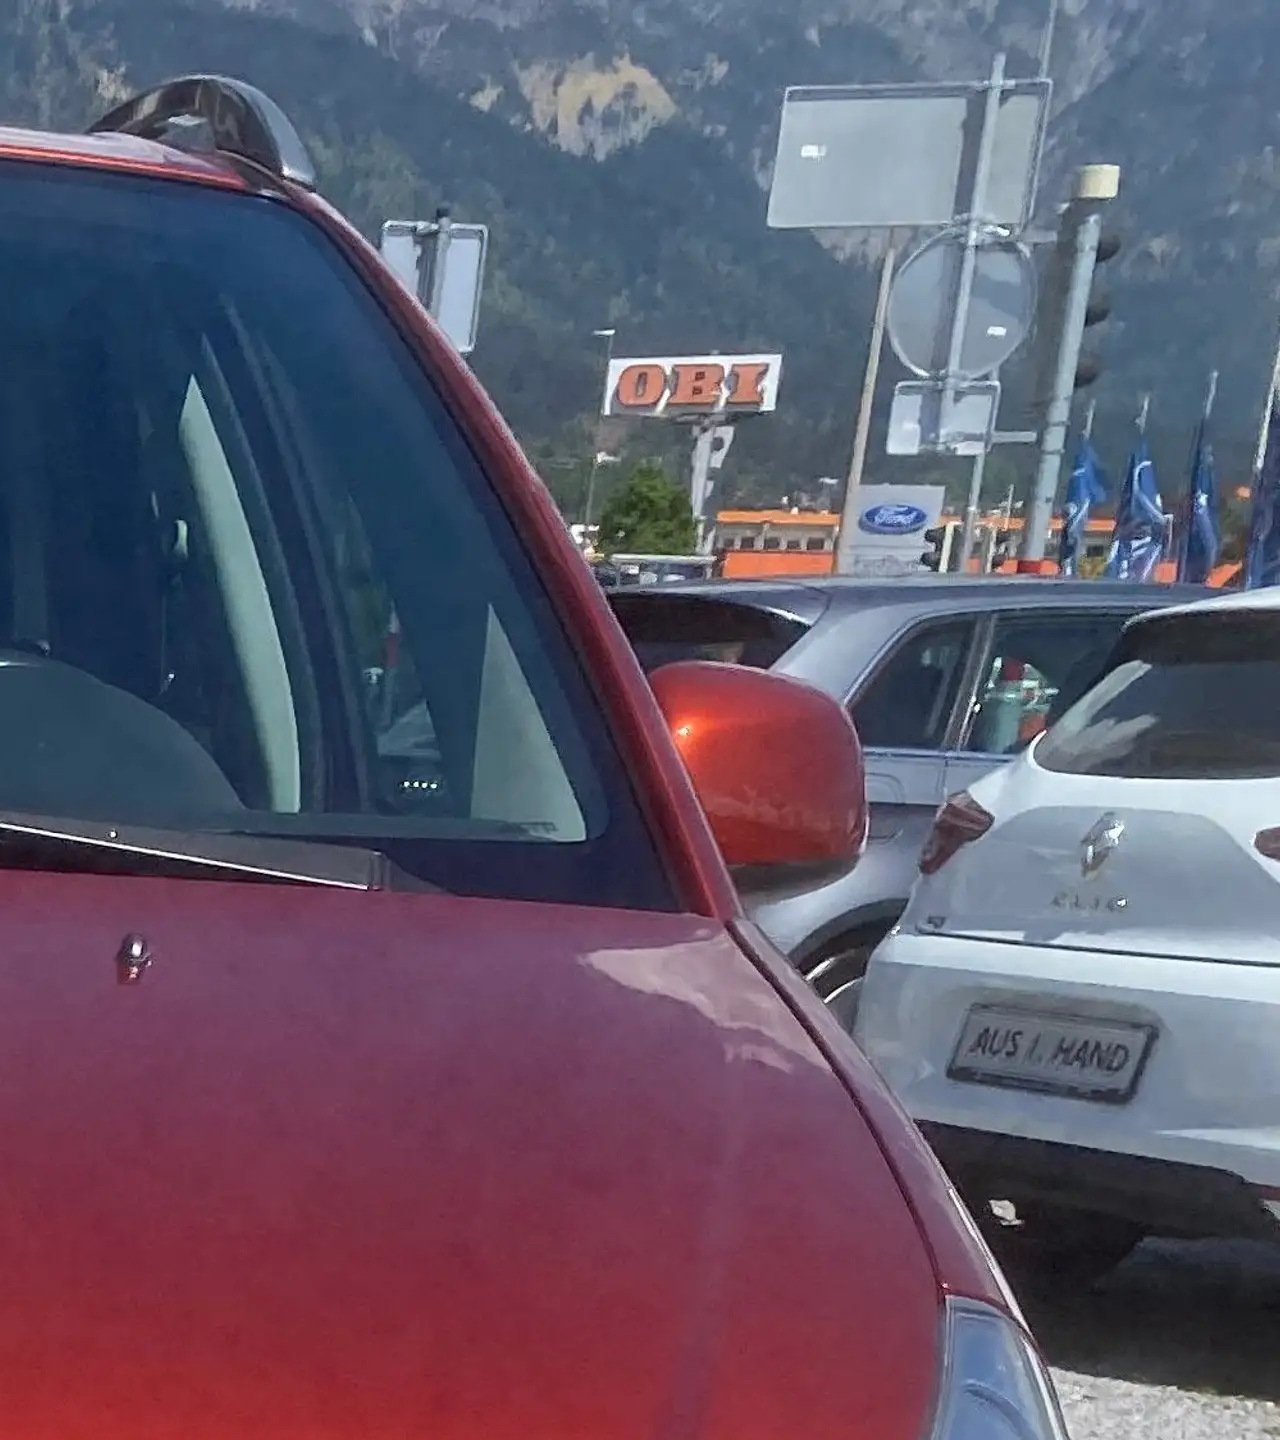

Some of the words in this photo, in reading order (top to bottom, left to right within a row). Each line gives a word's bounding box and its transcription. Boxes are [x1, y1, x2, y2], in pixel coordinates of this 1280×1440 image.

[617, 364, 769, 406] OBI
[967, 1027, 1023, 1057] AUS
[1048, 1036, 1130, 1072] HAND
